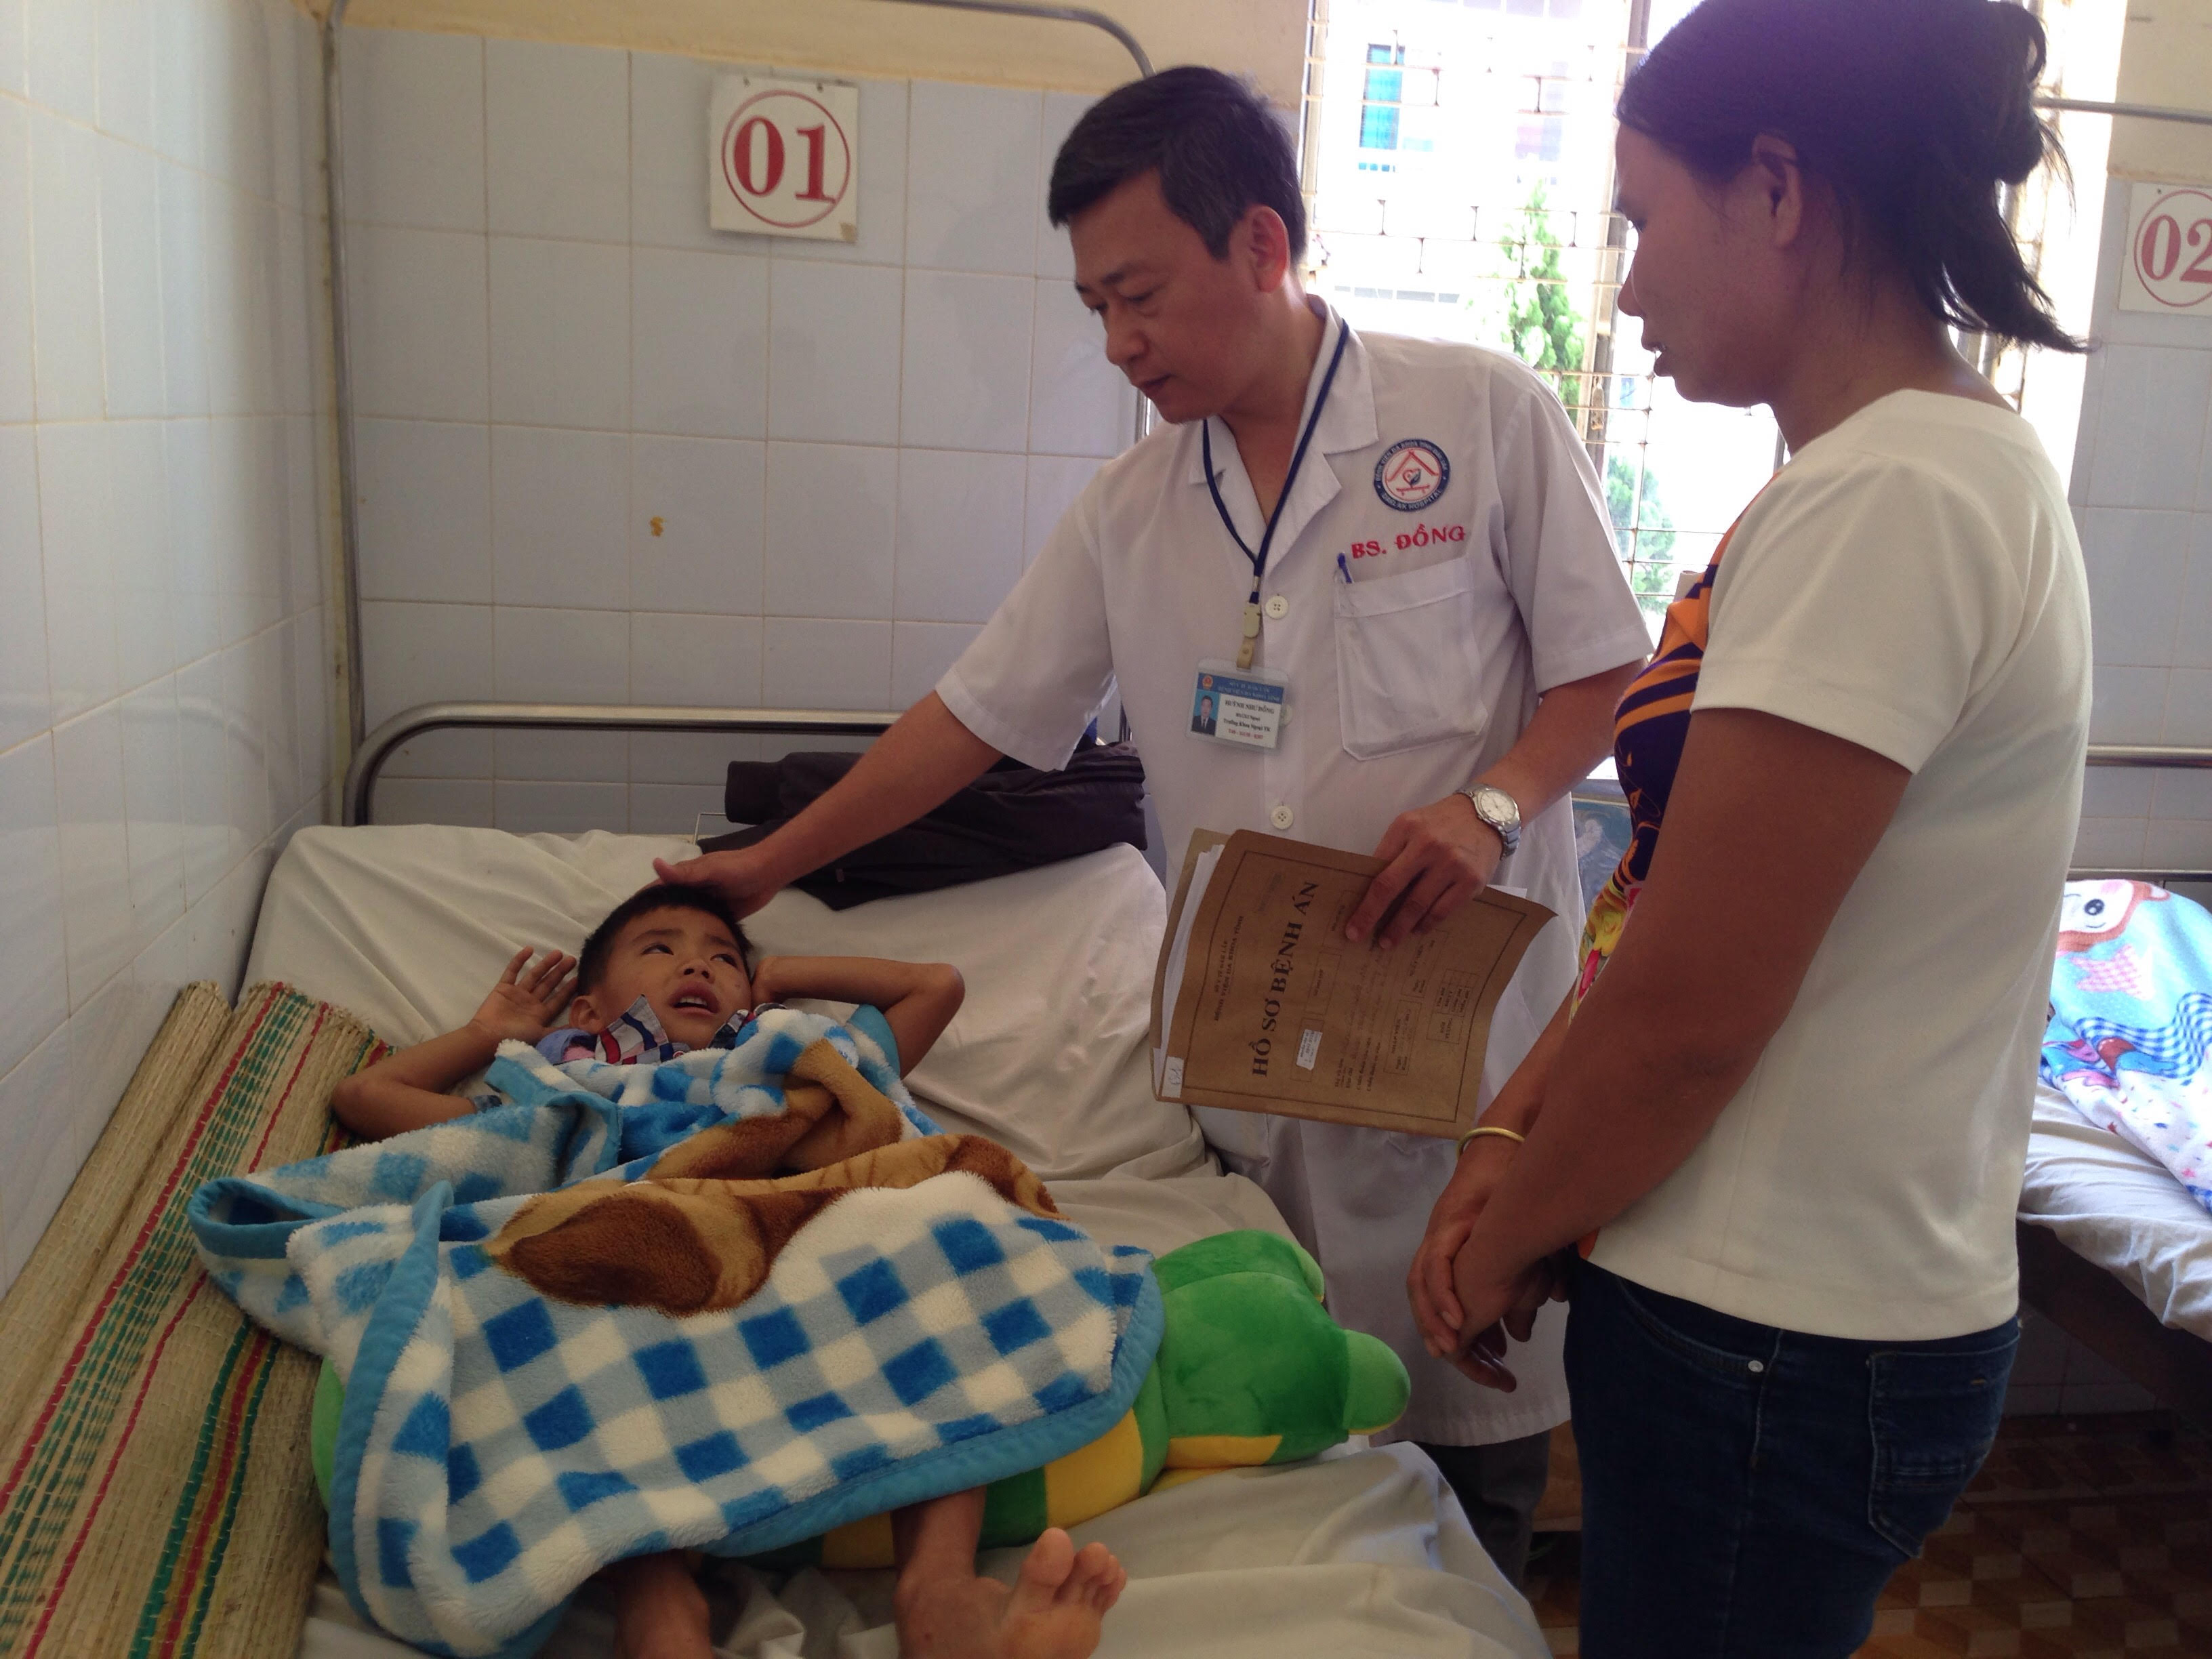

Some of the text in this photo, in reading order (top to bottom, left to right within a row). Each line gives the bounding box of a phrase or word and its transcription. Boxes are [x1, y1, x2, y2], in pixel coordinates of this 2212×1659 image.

[733, 115, 836, 204] 01
[2141, 213, 2212, 284] 02
[1351, 523, 1466, 559] BS. ĐỒNG
[1248, 882, 1319, 1078] HỒ SƠ BỆNH ÁN
